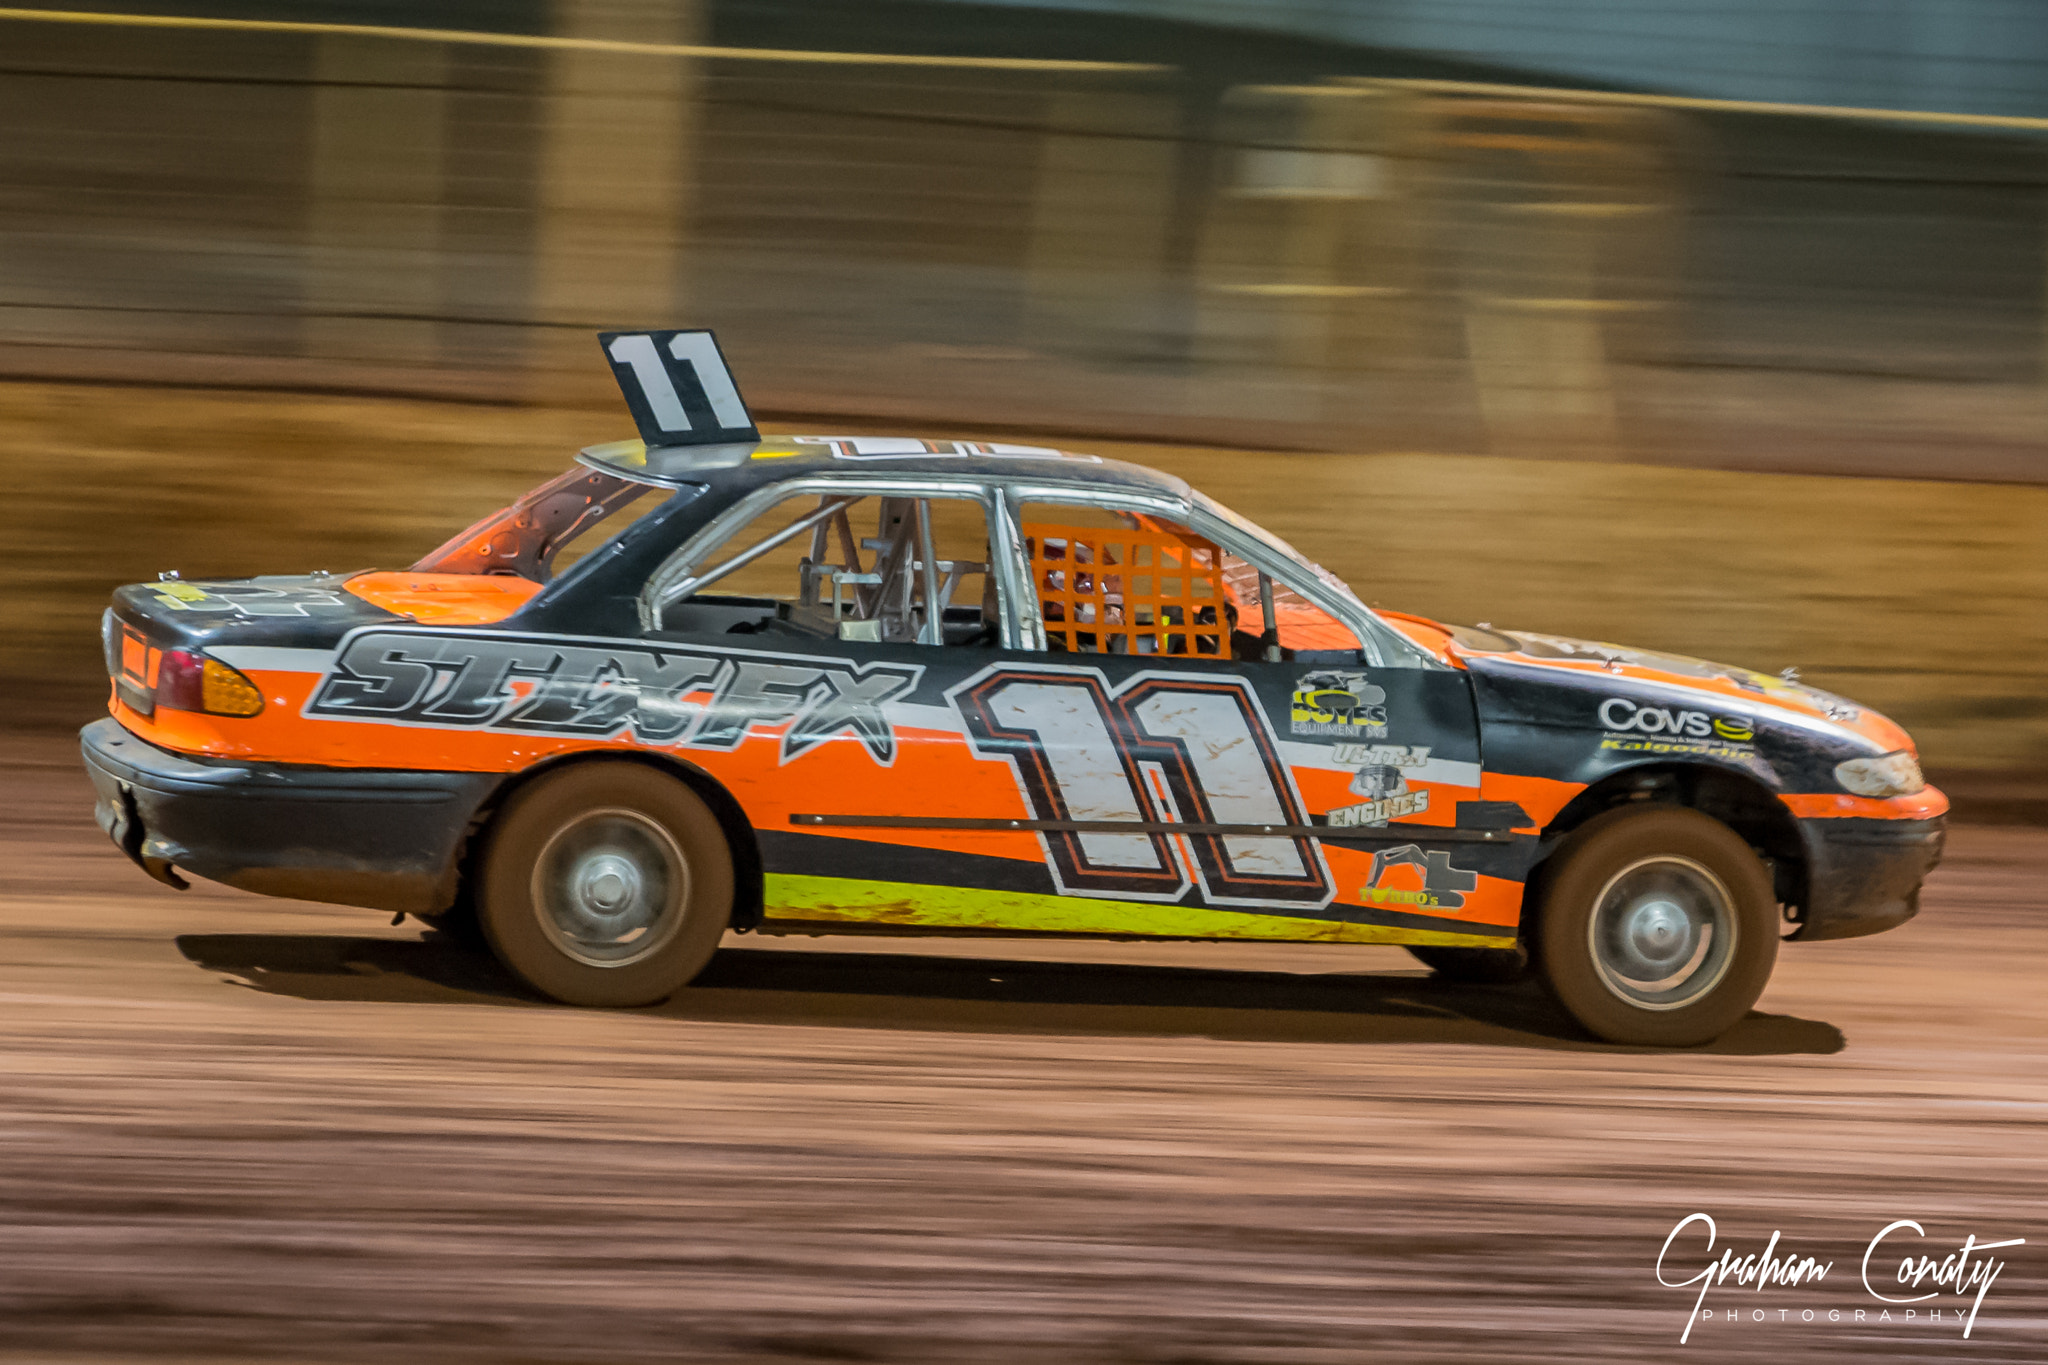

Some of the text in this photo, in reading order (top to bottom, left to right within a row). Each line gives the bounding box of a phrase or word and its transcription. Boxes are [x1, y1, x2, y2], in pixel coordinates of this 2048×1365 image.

[608, 334, 752, 432] 11
[1291, 703, 1388, 727] BOYES
[1291, 721, 1361, 736] EQUIPMENT
[1333, 743, 1432, 767] ULTRA
[943, 661, 1338, 910] 11
[1326, 788, 1430, 829] ENGINES
